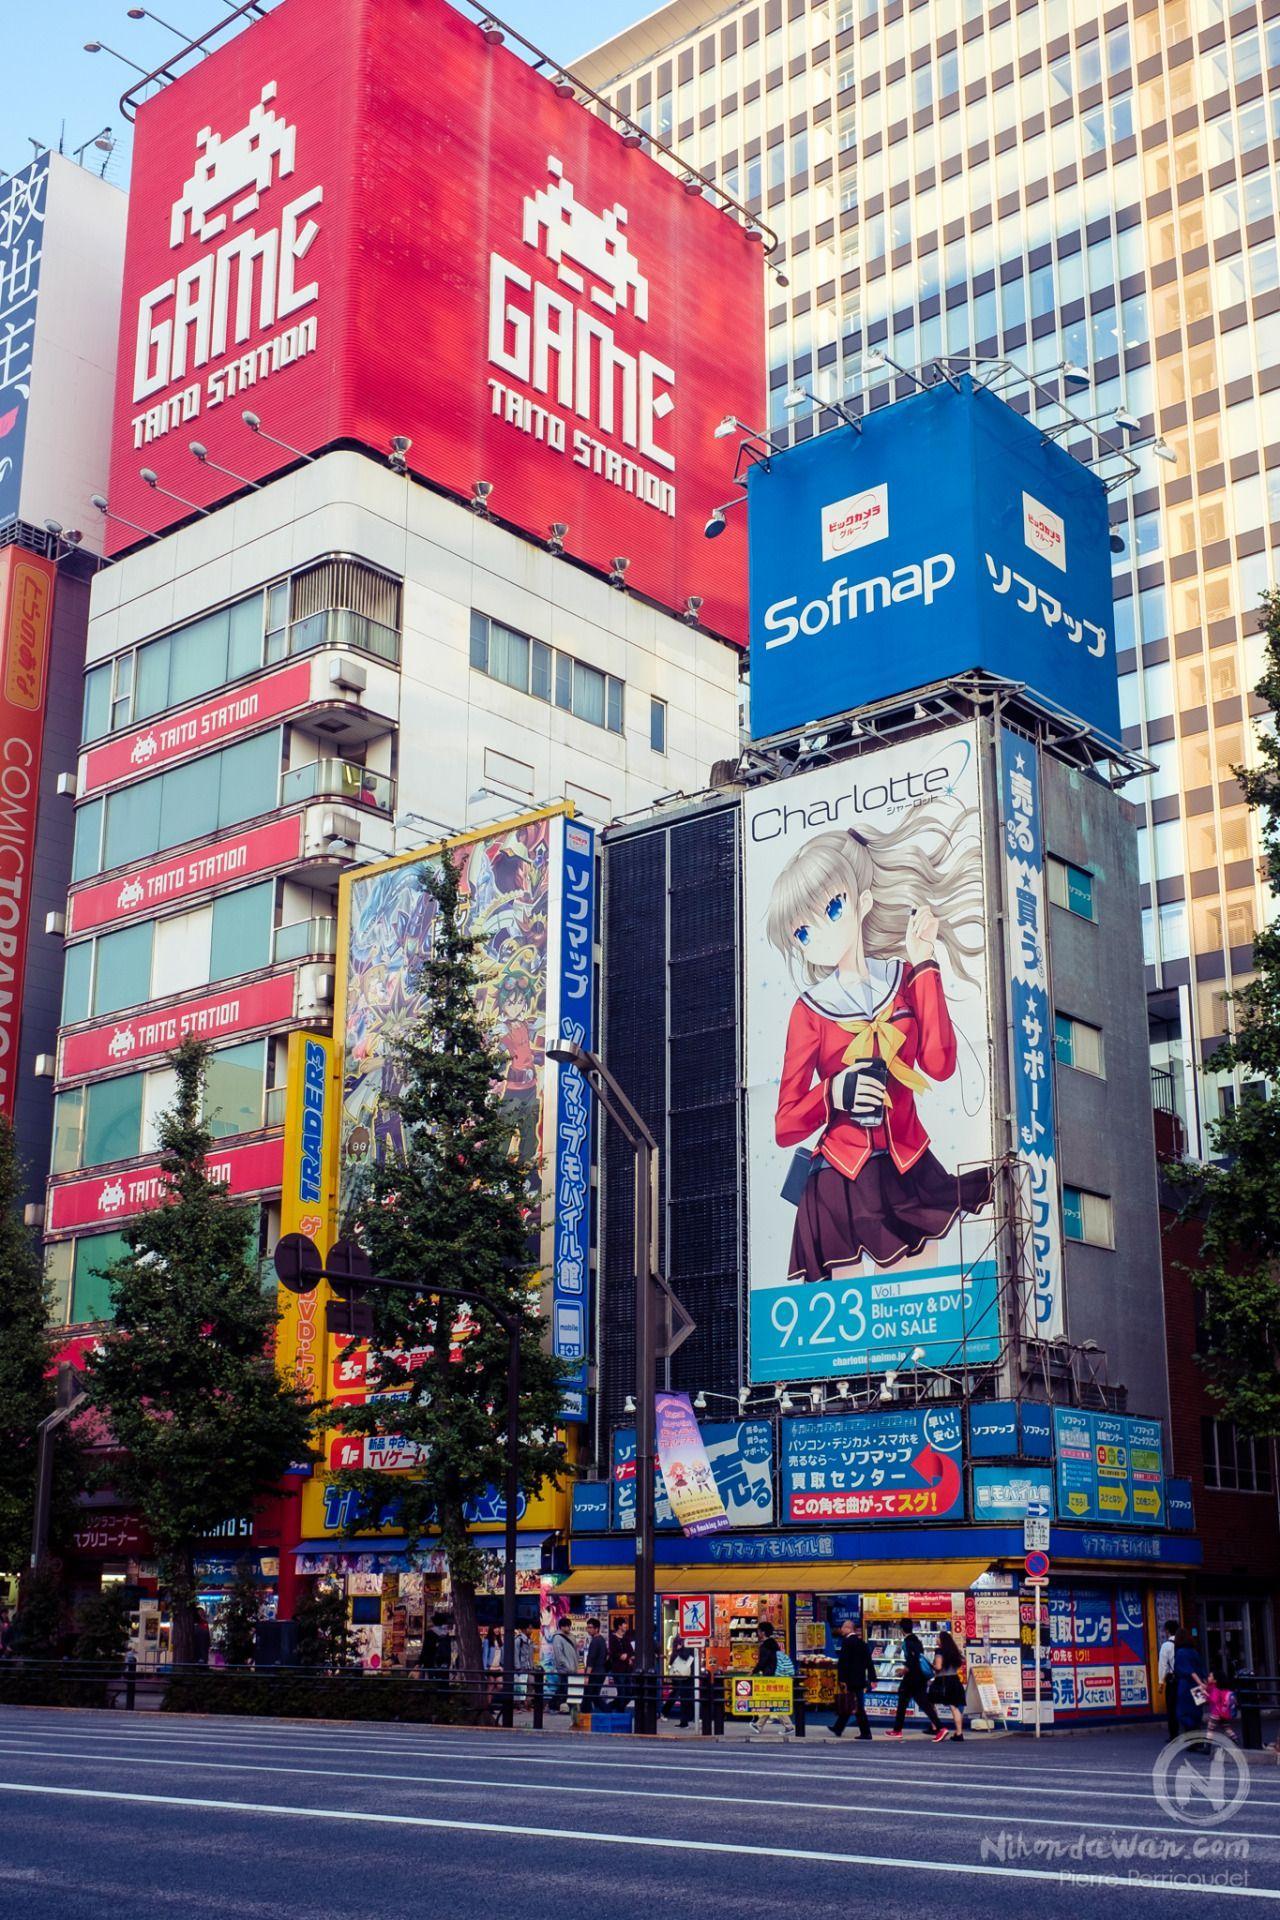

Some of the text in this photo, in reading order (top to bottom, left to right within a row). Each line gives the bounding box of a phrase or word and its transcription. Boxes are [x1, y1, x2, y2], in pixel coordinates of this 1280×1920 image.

[132, 185, 323, 403] GAME
[488, 252, 675, 471] GAME
[131, 316, 317, 449] TAITO STATION
[488, 378, 675, 518] TAITO STATION
[829, 505, 881, 533] ビックカメラ
[839, 519, 869, 539] グループ
[1027, 514, 1061, 544] ビックカメラ
[764, 553, 956, 650] Sofmap
[985, 552, 1106, 658] ソフマップ
[160, 694, 258, 751] TAITO STATION
[752, 767, 949, 842] Charlotte
[887, 794, 938, 816] シャーロット
[147, 845, 247, 898] TAITO STATION
[564, 864, 590, 999] ソフマップ
[138, 1000, 239, 1048] TAITO STATION
[557, 1017, 587, 1294] ソマップモバイル館
[1028, 1161, 1053, 1323] ソフマップ
[874, 1285, 901, 1298] Vol.1
[771, 1288, 866, 1348] 9.23
[872, 1302, 923, 1320] Blu-ray
[872, 1317, 937, 1339] ON SALE
[340, 1361, 362, 1380] 3F
[973, 1424, 1015, 1435] ソフマップ
[1023, 1425, 1049, 1435] ソフマップ
[368, 1438, 385, 1450] 新品
[788, 1433, 919, 1452] パソコン・デジカメ・スマホを
[341, 1445, 359, 1465] 1F
[841, 1448, 912, 1466] ソフマップ
[791, 1469, 906, 1490] 買取センター
[574, 1503, 606, 1513] ソフマップ
[1170, 1500, 1191, 1510] ソフマップ
[710, 1535, 834, 1559] ソフマップモバイル館
[991, 1653, 1018, 1665] Free
